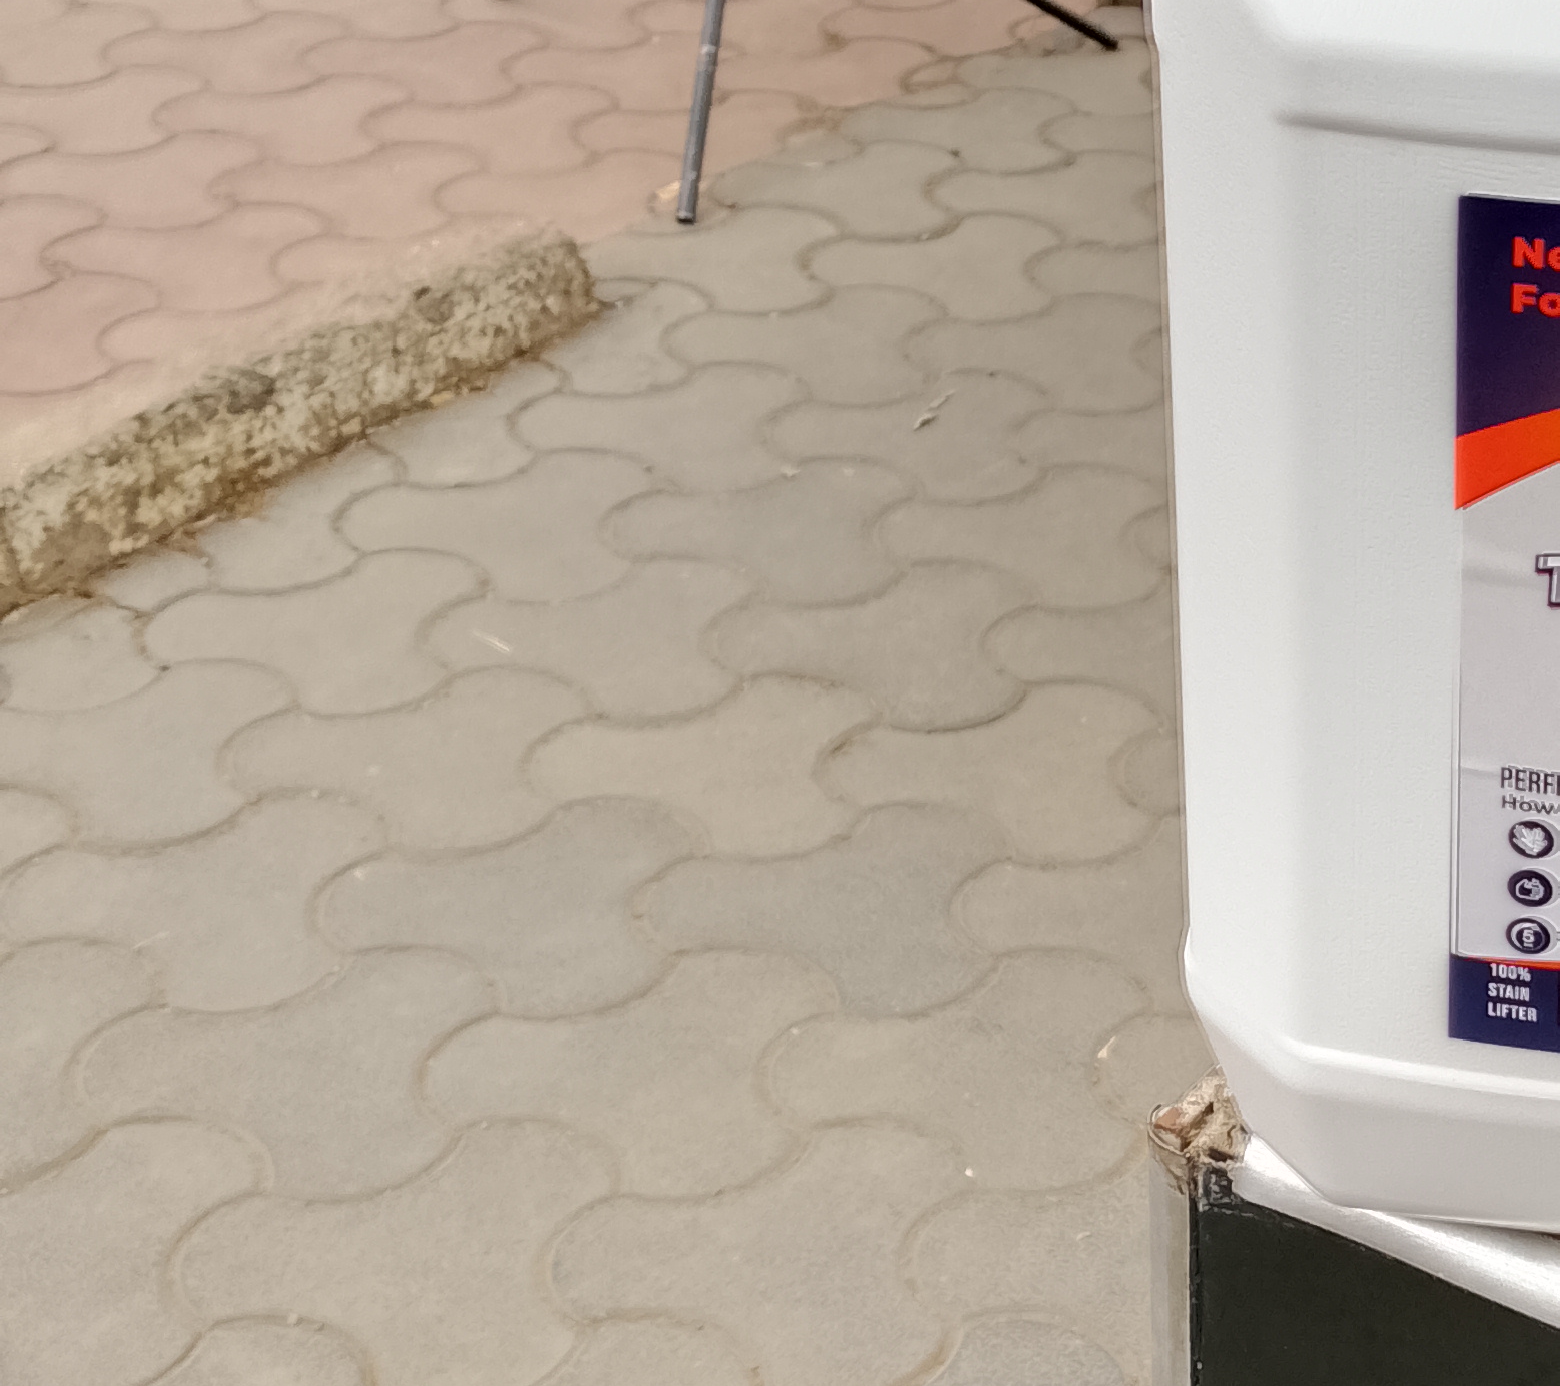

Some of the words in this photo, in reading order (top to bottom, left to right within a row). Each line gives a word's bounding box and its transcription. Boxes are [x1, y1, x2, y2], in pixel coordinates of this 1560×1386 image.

[1501, 794, 1555, 815] How
[1490, 963, 1532, 982] 100%
[1488, 982, 1530, 1002] STAIN
[1488, 1002, 1538, 1023] LIFTER
